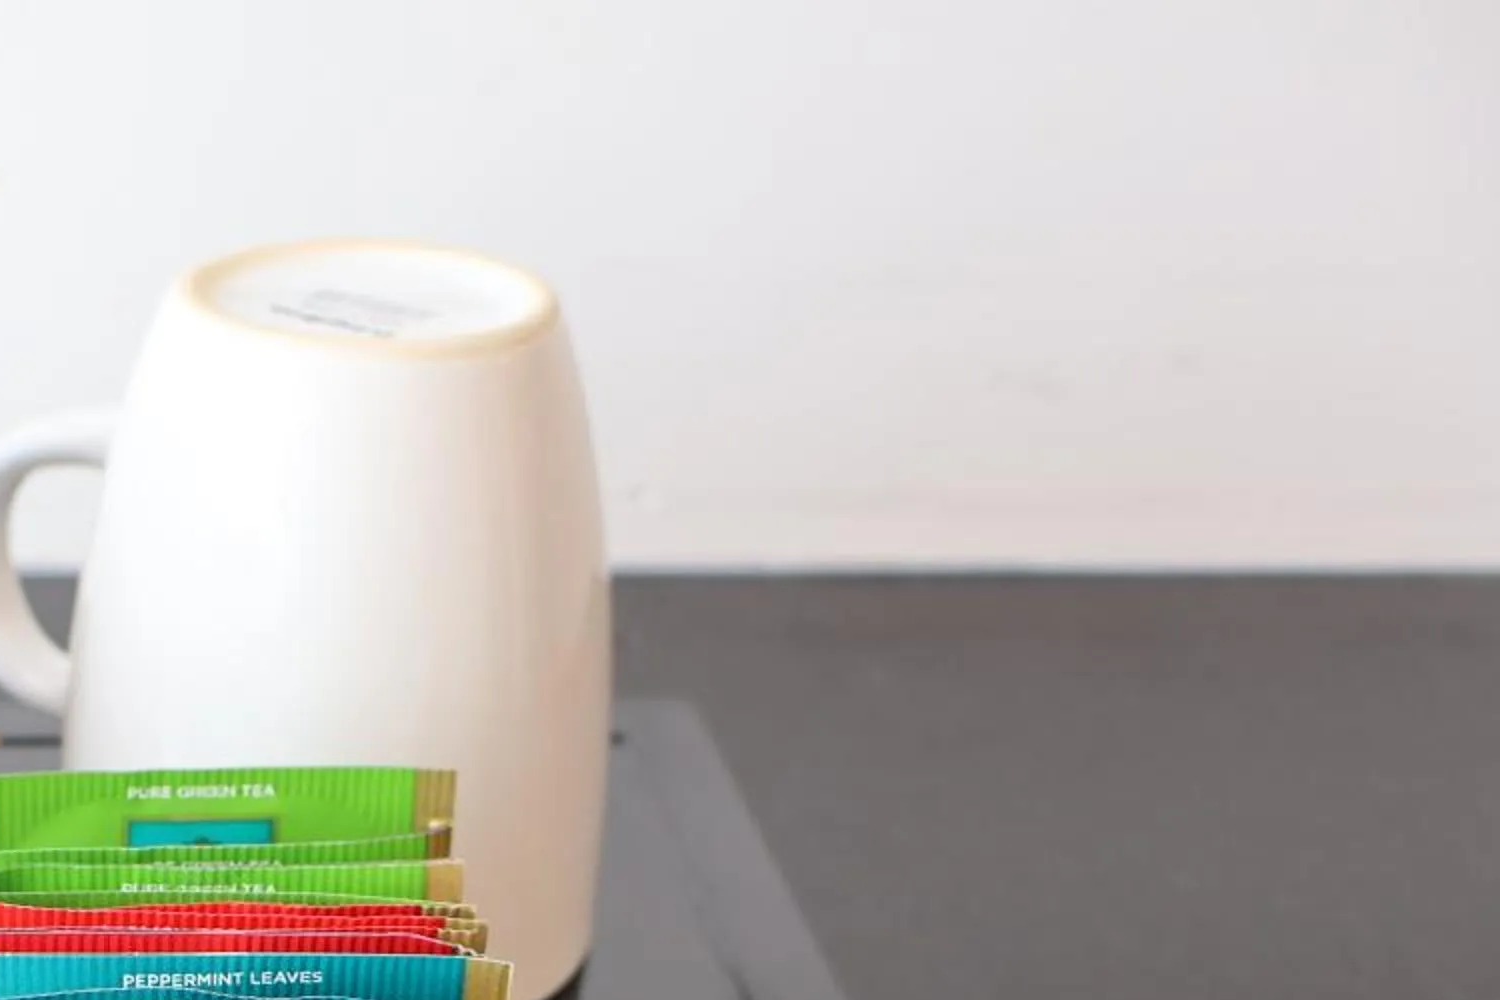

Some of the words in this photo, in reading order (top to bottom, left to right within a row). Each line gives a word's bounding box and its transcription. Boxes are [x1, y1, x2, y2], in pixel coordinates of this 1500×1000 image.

[127, 784, 171, 799] PURE
[177, 784, 237, 798] GREEN
[243, 783, 276, 797] TEA
[122, 971, 244, 988] PEPPERMINT
[250, 971, 323, 985] LEAVES
